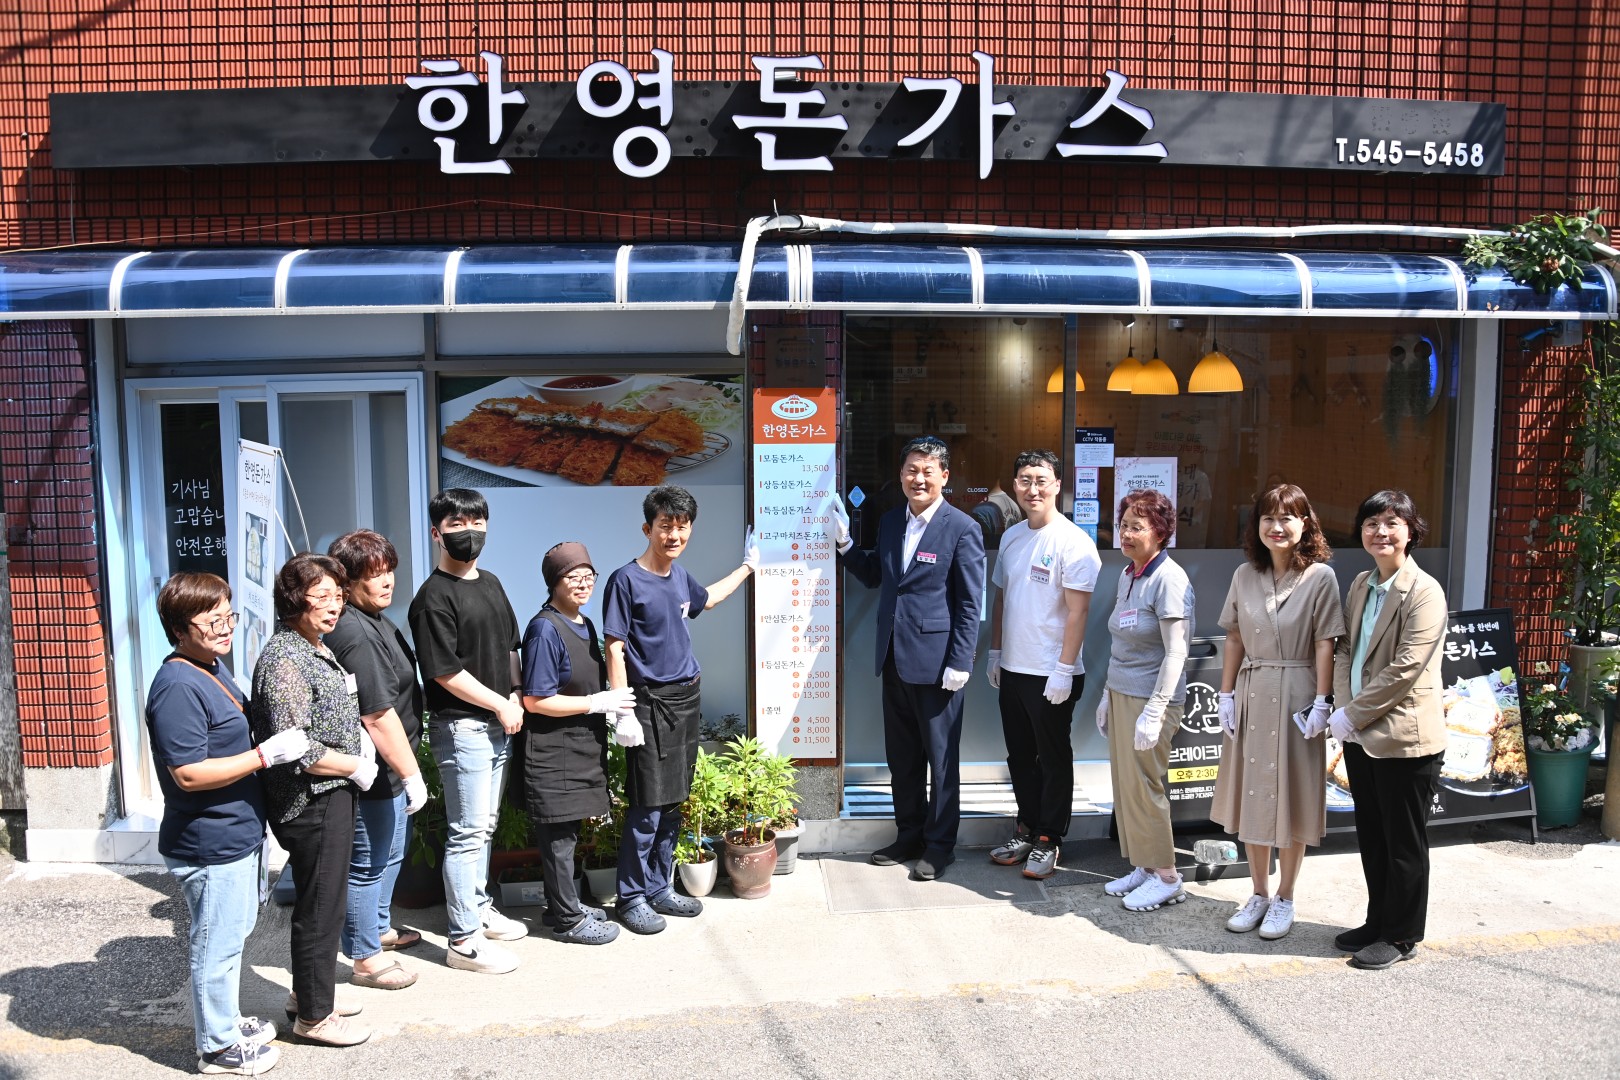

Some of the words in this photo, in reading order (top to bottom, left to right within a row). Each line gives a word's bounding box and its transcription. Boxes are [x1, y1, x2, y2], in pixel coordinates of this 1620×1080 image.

[405, 48, 1168, 179] 한영돈가스
[1336, 138, 1484, 167] T.545-5458
[762, 424, 826, 438] 한영돈가스
[245, 460, 270, 486] 한영돈가스
[172, 478, 210, 499] 기사님
[764, 532, 828, 540] 고구마치즈돈가스
[176, 536, 227, 556] 안전운행
[764, 568, 804, 577] 치즈돈가스
[803, 589, 829, 597] 12,500
[1169, 745, 1222, 762] 브레이크
[1177, 770, 1193, 780] 오후
